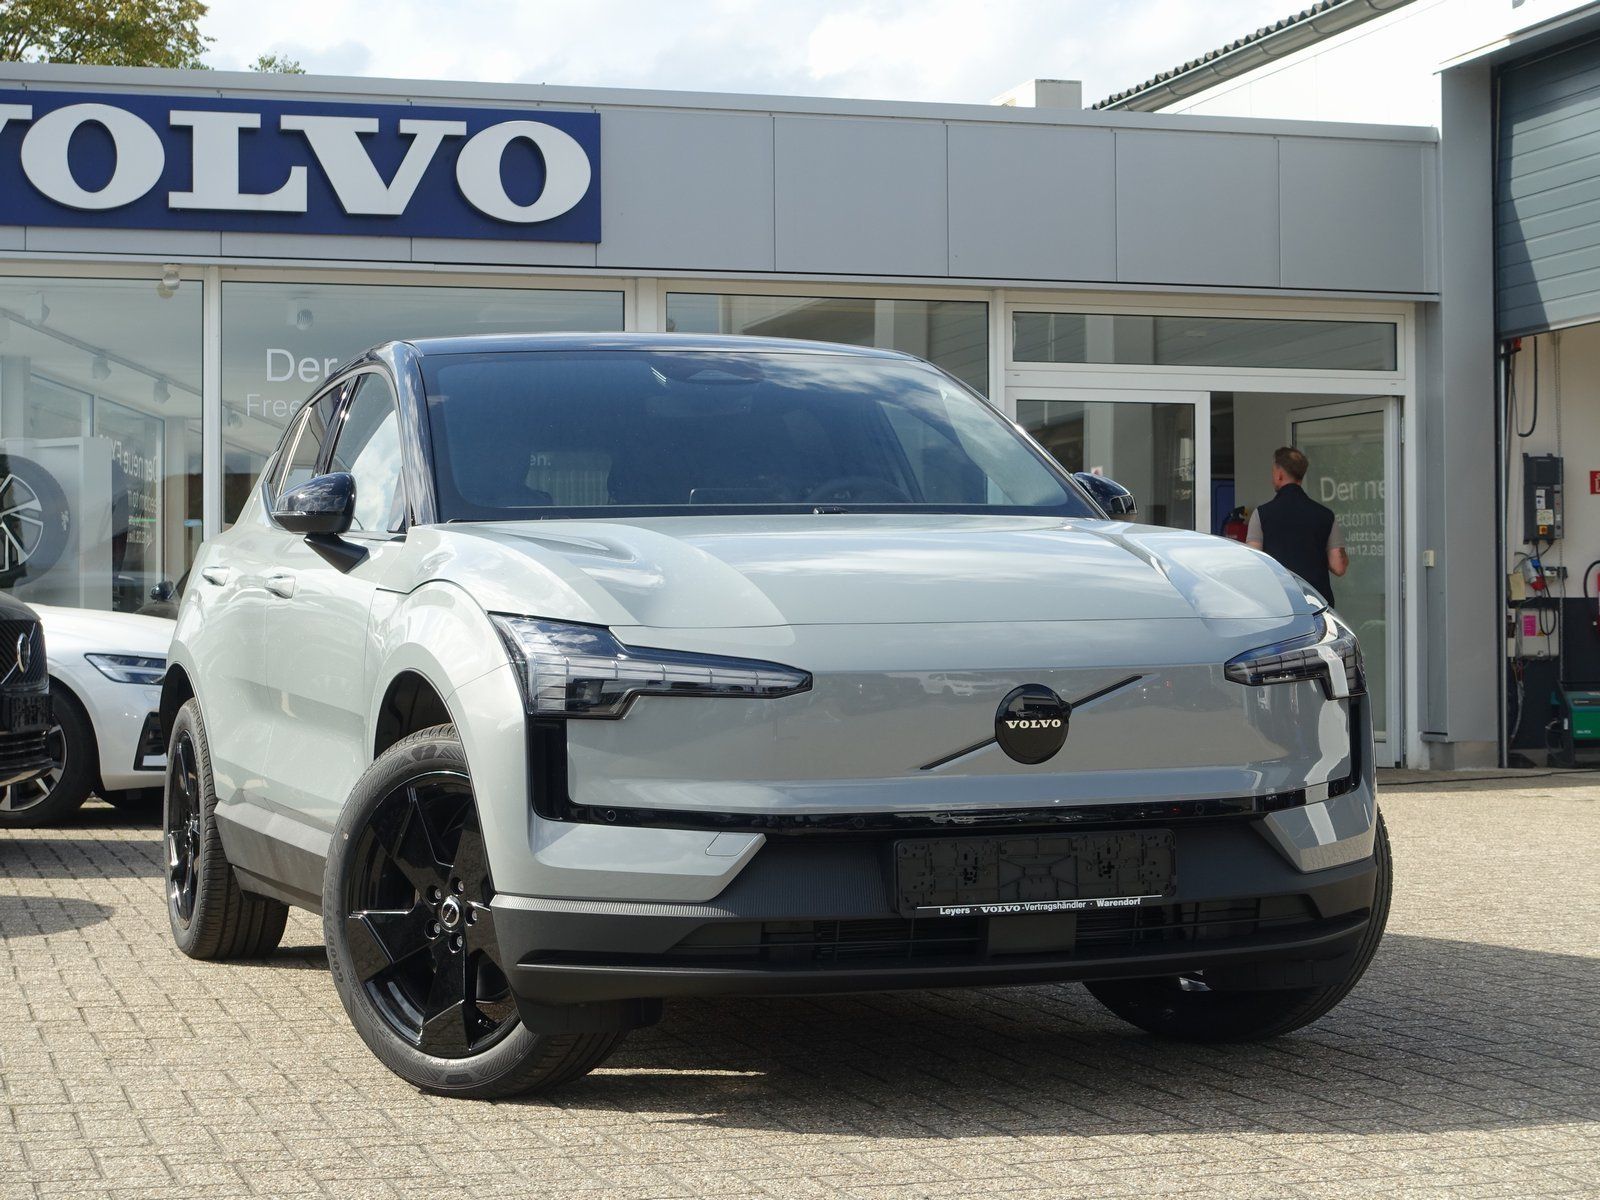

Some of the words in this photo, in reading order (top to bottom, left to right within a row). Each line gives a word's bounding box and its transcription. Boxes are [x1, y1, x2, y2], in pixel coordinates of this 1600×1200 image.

[0, 102, 592, 224] OLVO
[266, 348, 338, 382] Der
[1320, 477, 1359, 501] Der
[1005, 718, 1062, 729] VOLVO
[939, 906, 971, 916] Leyers
[1096, 897, 1141, 908] Warendorf
